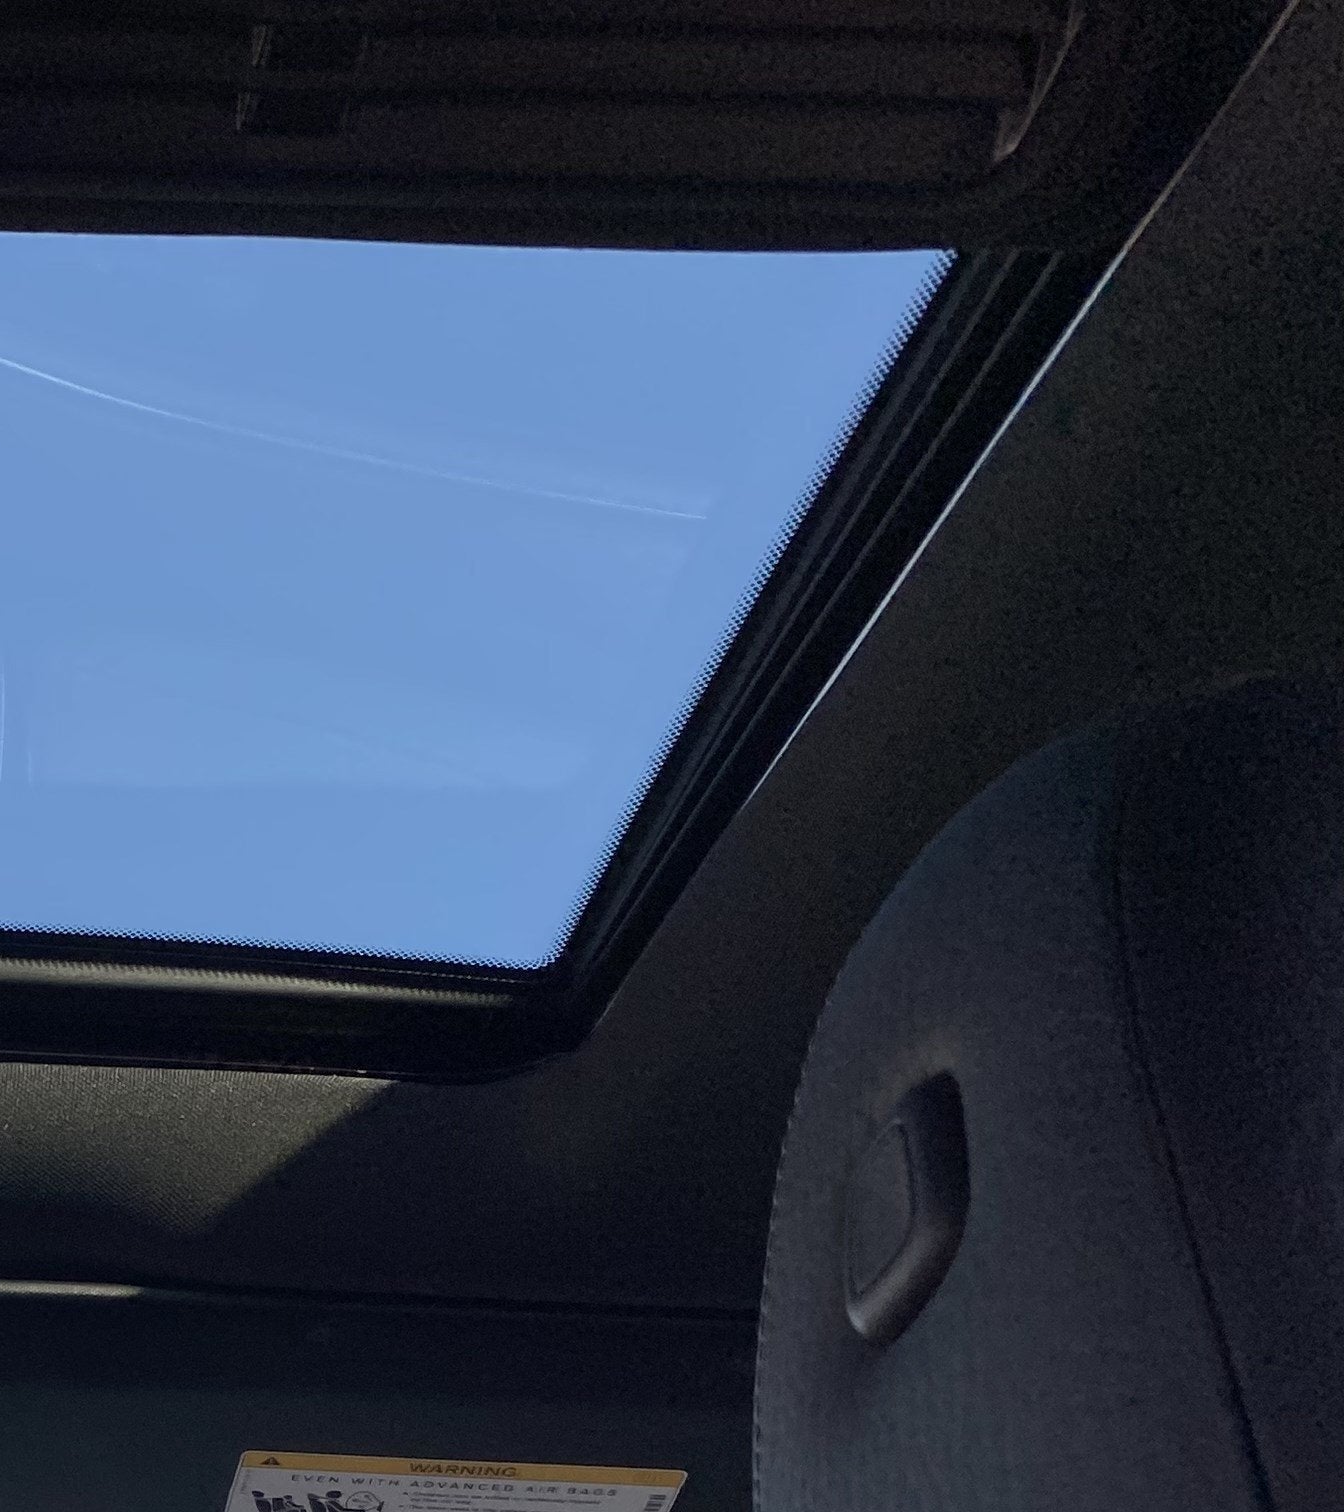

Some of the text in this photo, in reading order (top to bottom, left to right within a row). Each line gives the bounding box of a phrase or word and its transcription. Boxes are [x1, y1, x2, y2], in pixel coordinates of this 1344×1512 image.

[409, 1462, 519, 1478] WARNING
[291, 1474, 618, 1497] EVEN WITH ADVANCED AIR BAGS
